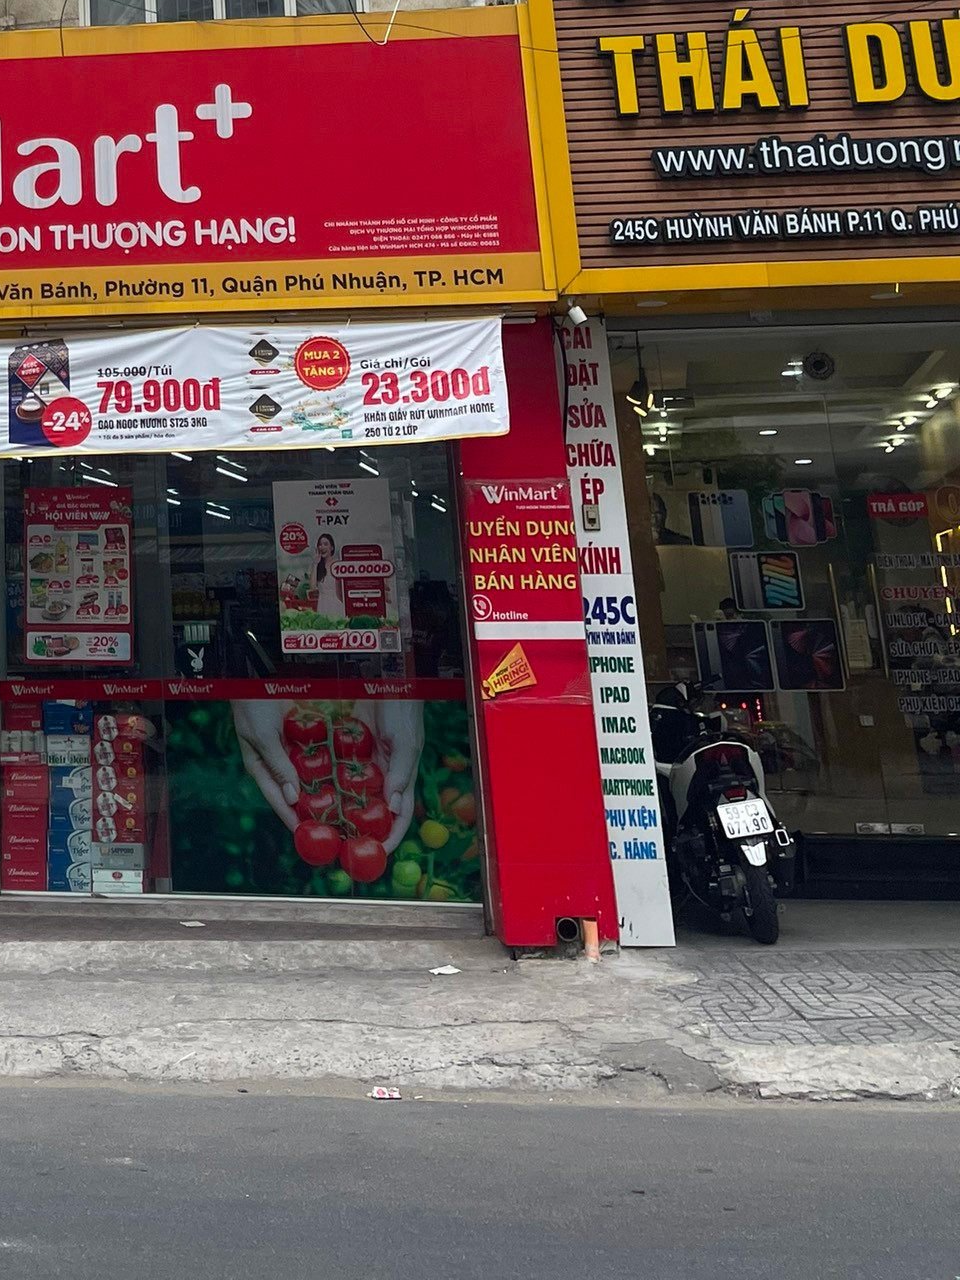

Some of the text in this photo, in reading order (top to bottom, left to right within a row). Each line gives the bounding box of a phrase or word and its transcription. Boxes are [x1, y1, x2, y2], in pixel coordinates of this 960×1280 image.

[599, 8, 809, 115] THÁI
[614, 203, 959, 240] 245C HUỲNH VĂN BÁNH P.11 Q. PHÚ
[48, 219, 187, 254] THƯỢNG
[194, 216, 296, 250] HẠNG!
[41, 281, 98, 301] Bánh,
[105, 279, 184, 300] Phường
[191, 278, 214, 296] 11,
[221, 275, 277, 297] Quận
[285, 273, 324, 292] Phú
[332, 271, 407, 293] Nhuận,
[414, 270, 446, 287] TP.
[454, 268, 503, 286] HCM
[304, 350, 340, 360] MUA 2
[360, 359, 381, 369] Giá
[303, 365, 336, 378] TẶNG
[361, 366, 490, 406] 23.300đ
[97, 377, 221, 414] 79.900đ
[470, 403, 495, 414] HOME
[569, 397, 607, 428] SỬA
[169, 417, 189, 428] ST25
[190, 417, 207, 428] 3KG
[365, 427, 381, 437] 250
[395, 426, 401, 436] 2
[566, 440, 616, 467] CHỮA
[581, 474, 604, 504] ÉP
[871, 498, 925, 514] TRẢ GÓP
[316, 515, 350, 526] T-PAY
[469, 516, 520, 537] UYỂN
[470, 543, 576, 563] NHÂN VIÊN
[578, 542, 621, 574] KÍNH
[474, 570, 577, 590] BÁN HÀNG
[493, 611, 528, 620] Hotline
[589, 656, 635, 673] IPHONE
[600, 686, 630, 703] IPAD
[602, 717, 637, 733] IMAC
[600, 747, 646, 764] MACBOOK
[628, 805, 657, 830] KIỆN
[725, 804, 759, 820] 59-C3
